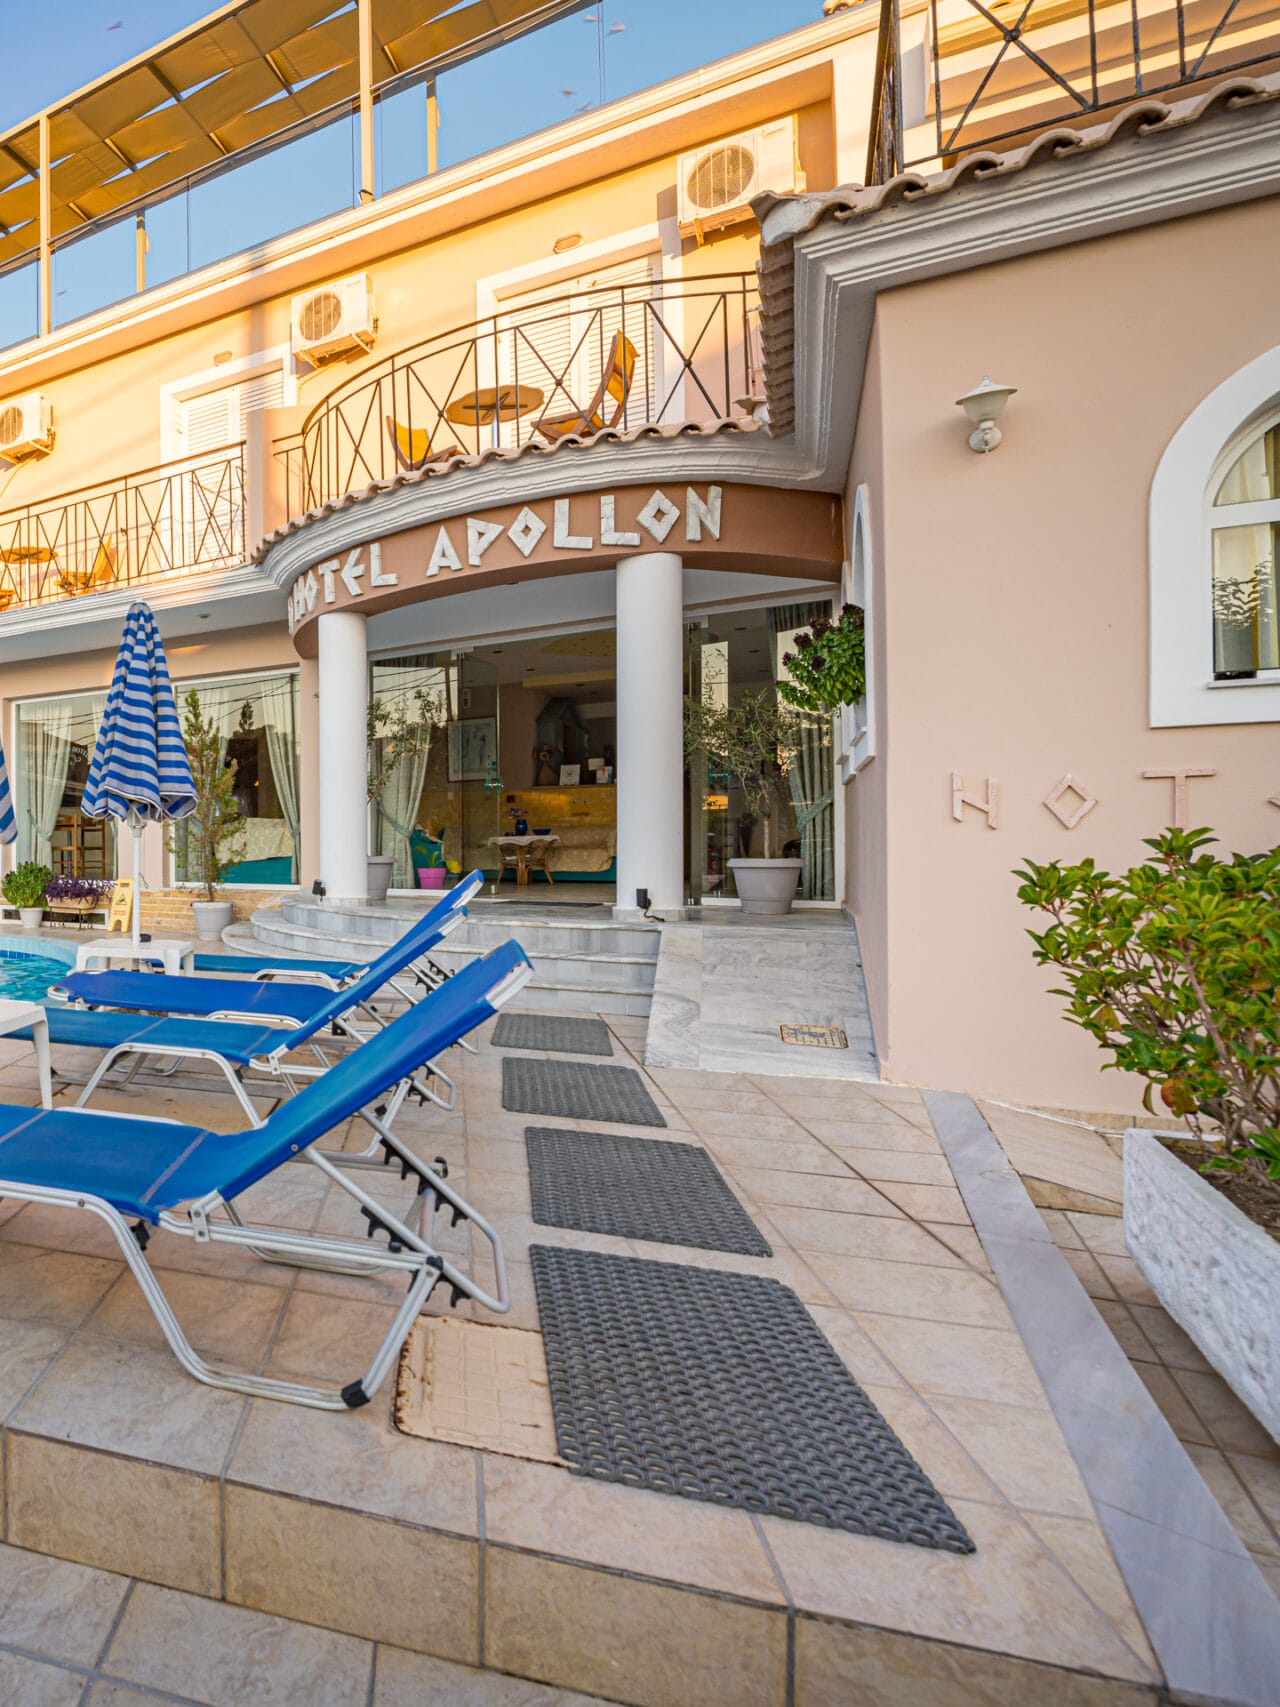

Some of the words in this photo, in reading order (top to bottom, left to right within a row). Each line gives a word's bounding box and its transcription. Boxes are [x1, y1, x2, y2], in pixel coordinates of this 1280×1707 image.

[294, 543, 398, 622] HOTEL
[426, 485, 723, 577] APOLLON
[951, 768, 1280, 830] HOT
